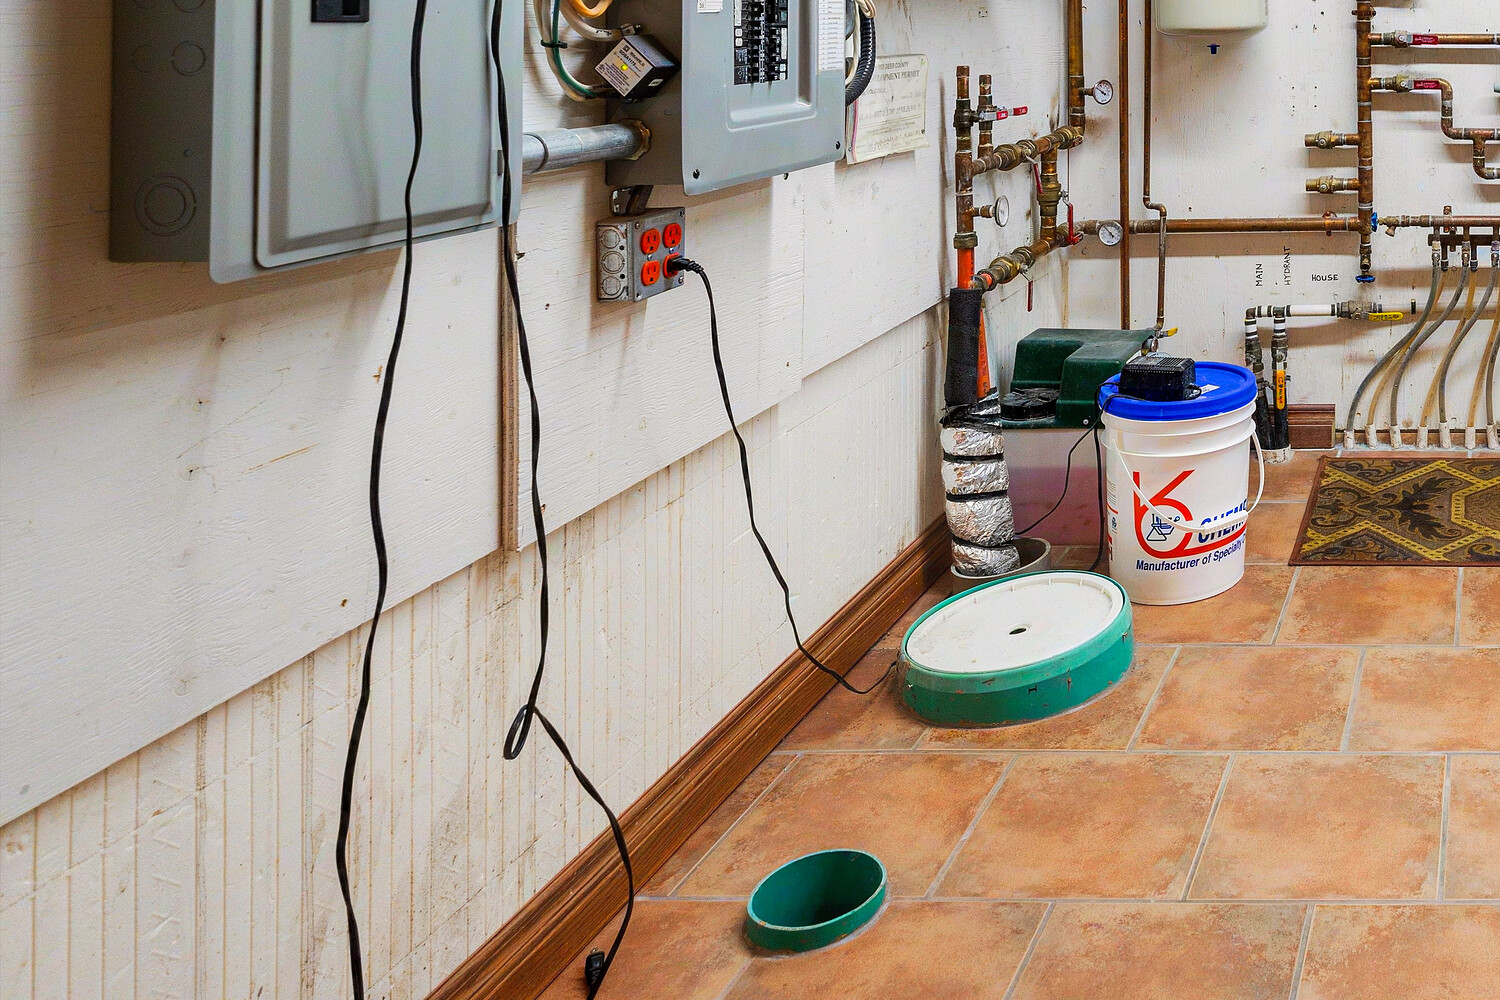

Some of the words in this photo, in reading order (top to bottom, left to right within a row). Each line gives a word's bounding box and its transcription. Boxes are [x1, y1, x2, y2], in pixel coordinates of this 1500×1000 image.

[1255, 263, 1263, 287] MAIN
[1283, 245, 1291, 286] HYDRANT
[1311, 274, 1339, 282] HOUSE
[1135, 557, 1200, 572] Manufacturer
[1201, 553, 1212, 565] of
[1213, 539, 1242, 562] Specialty
